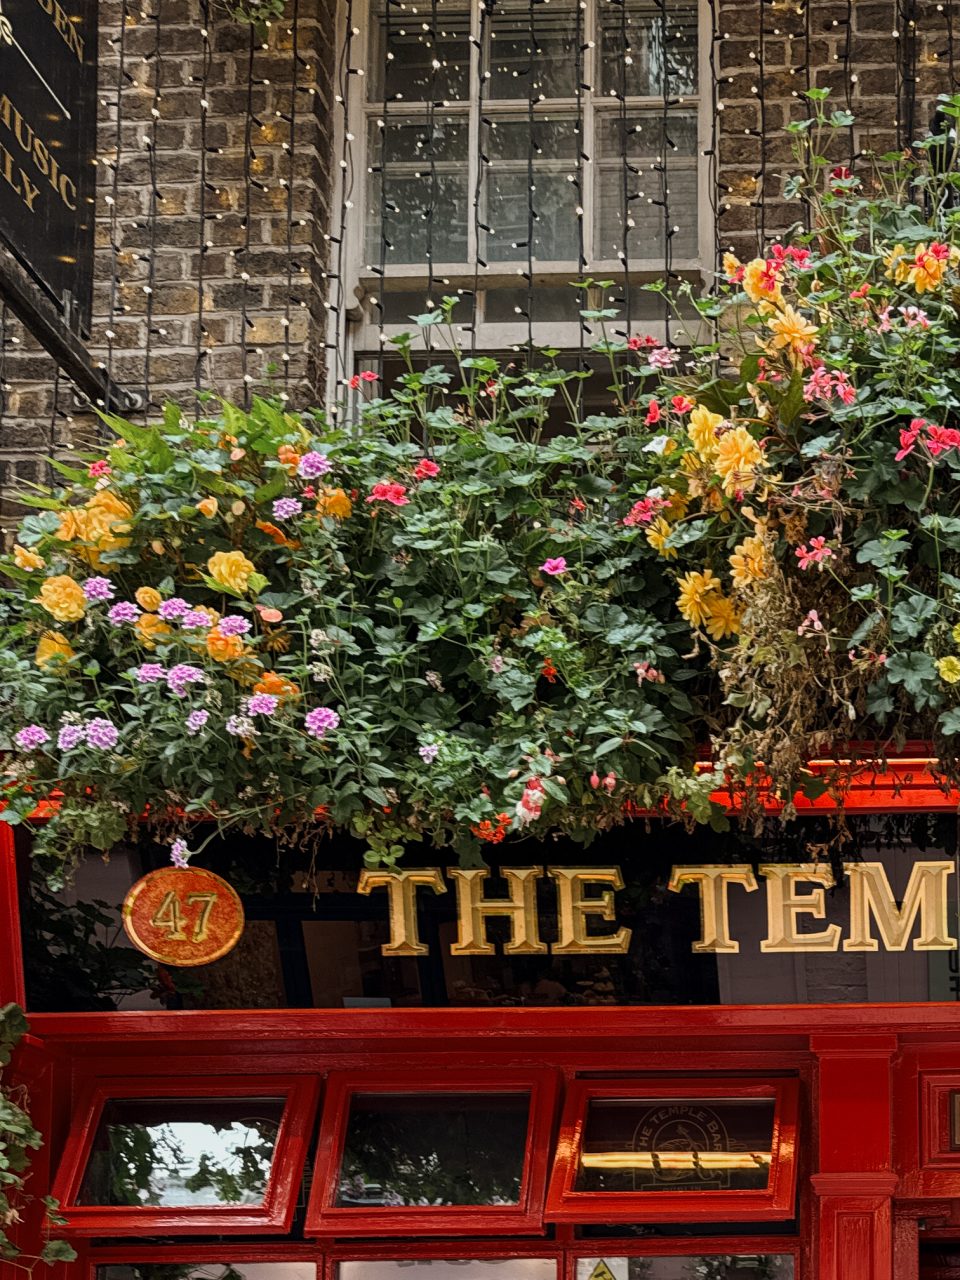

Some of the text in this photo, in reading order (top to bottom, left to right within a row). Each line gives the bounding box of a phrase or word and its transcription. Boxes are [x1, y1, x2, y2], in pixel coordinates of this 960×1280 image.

[149, 890, 218, 943] 47
[357, 865, 632, 956] THE
[649, 1105, 709, 1124] TEMPLE
